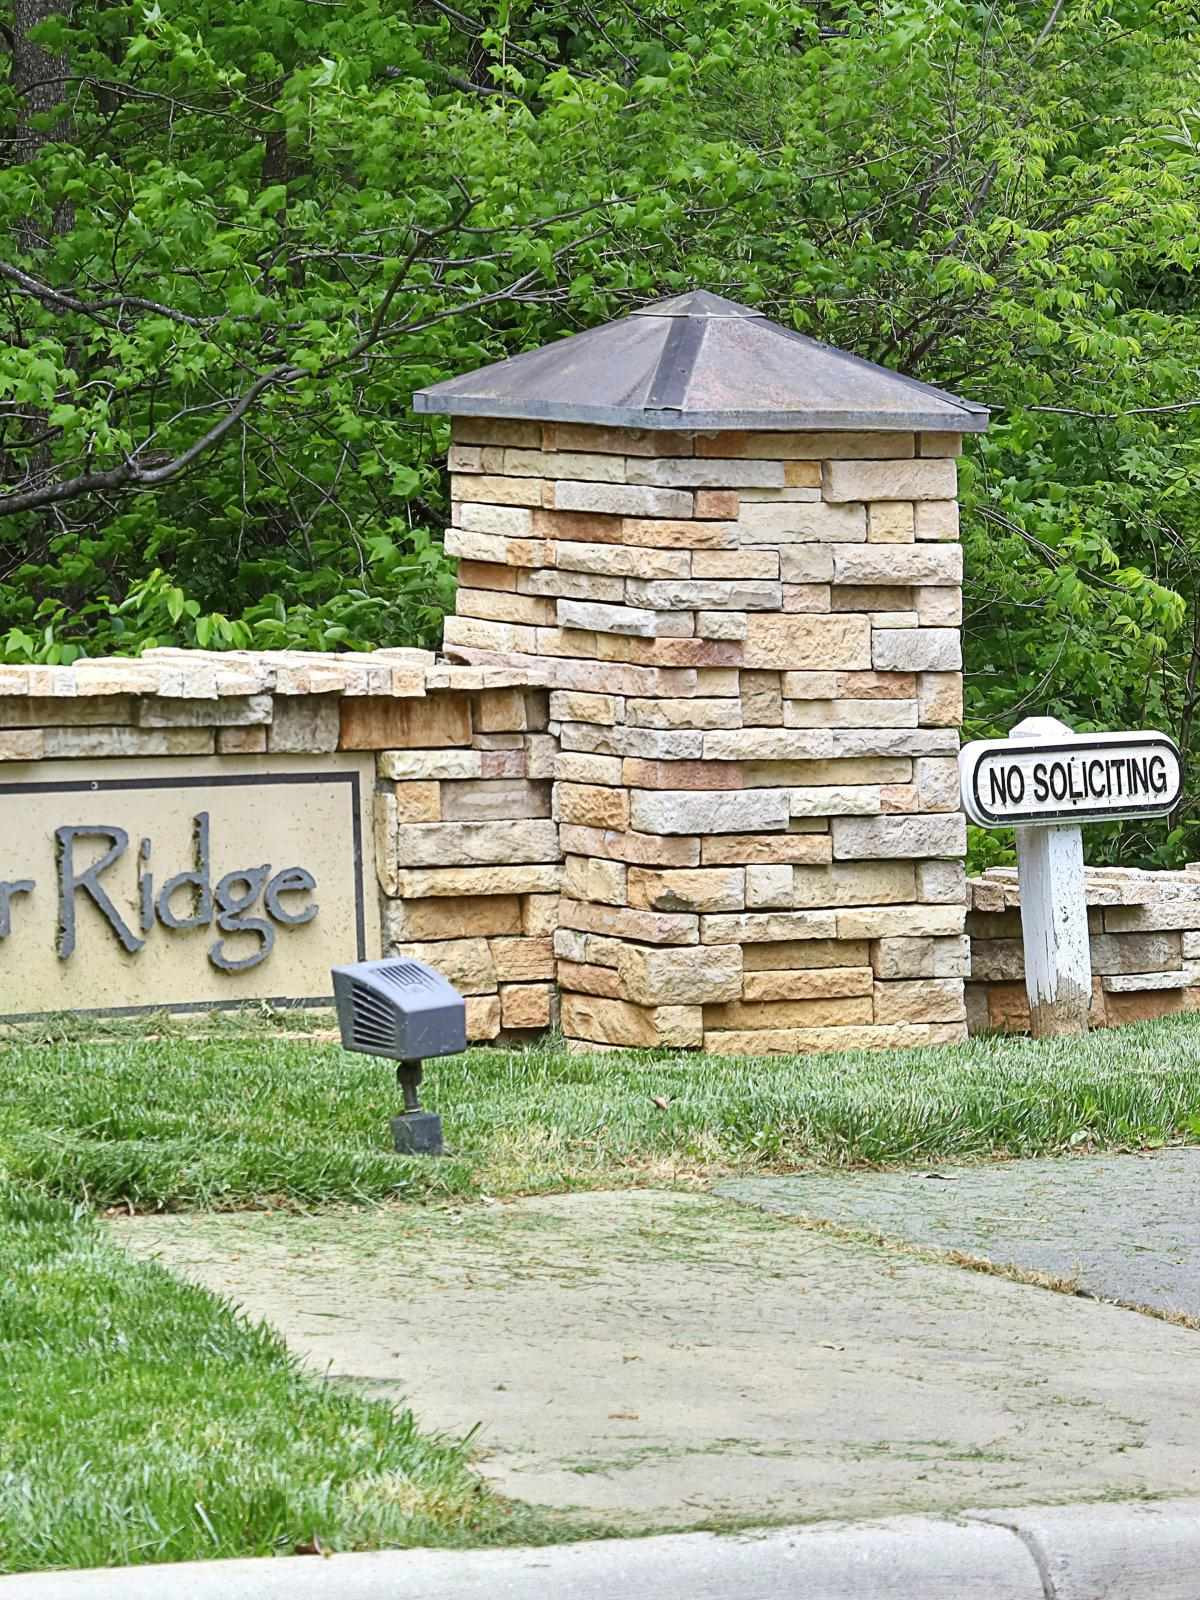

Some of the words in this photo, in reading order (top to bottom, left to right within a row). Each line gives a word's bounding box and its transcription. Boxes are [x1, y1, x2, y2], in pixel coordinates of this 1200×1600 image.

[990, 765, 1025, 804] NO
[1033, 755, 1168, 802] SOLICITING
[55, 811, 319, 972] Ridge
